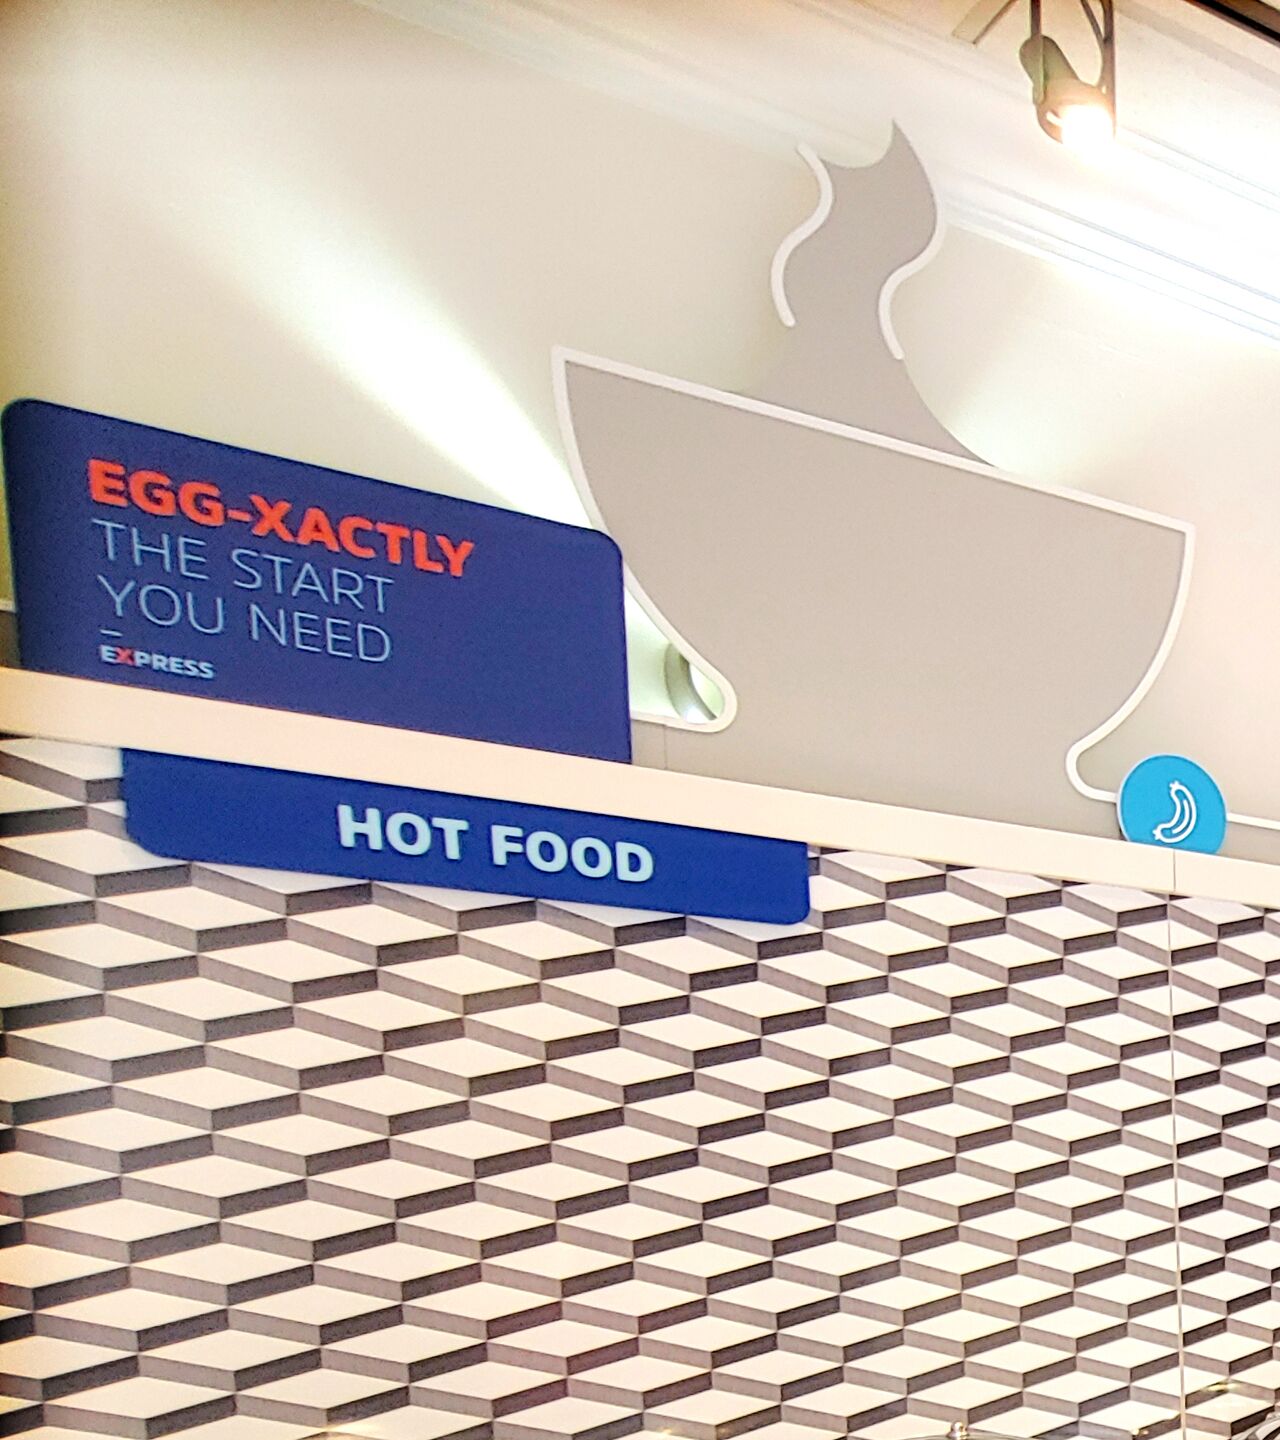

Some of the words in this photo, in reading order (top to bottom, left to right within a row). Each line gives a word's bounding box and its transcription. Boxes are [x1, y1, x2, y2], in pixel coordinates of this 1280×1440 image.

[87, 457, 474, 578] EGG-XACTLY
[92, 517, 209, 581] THE
[231, 548, 395, 613] START
[97, 573, 225, 636] YOU
[248, 603, 392, 664] NEED
[100, 644, 215, 680] EXPRESS
[337, 804, 470, 862] HOT
[490, 824, 655, 883] FOOD
